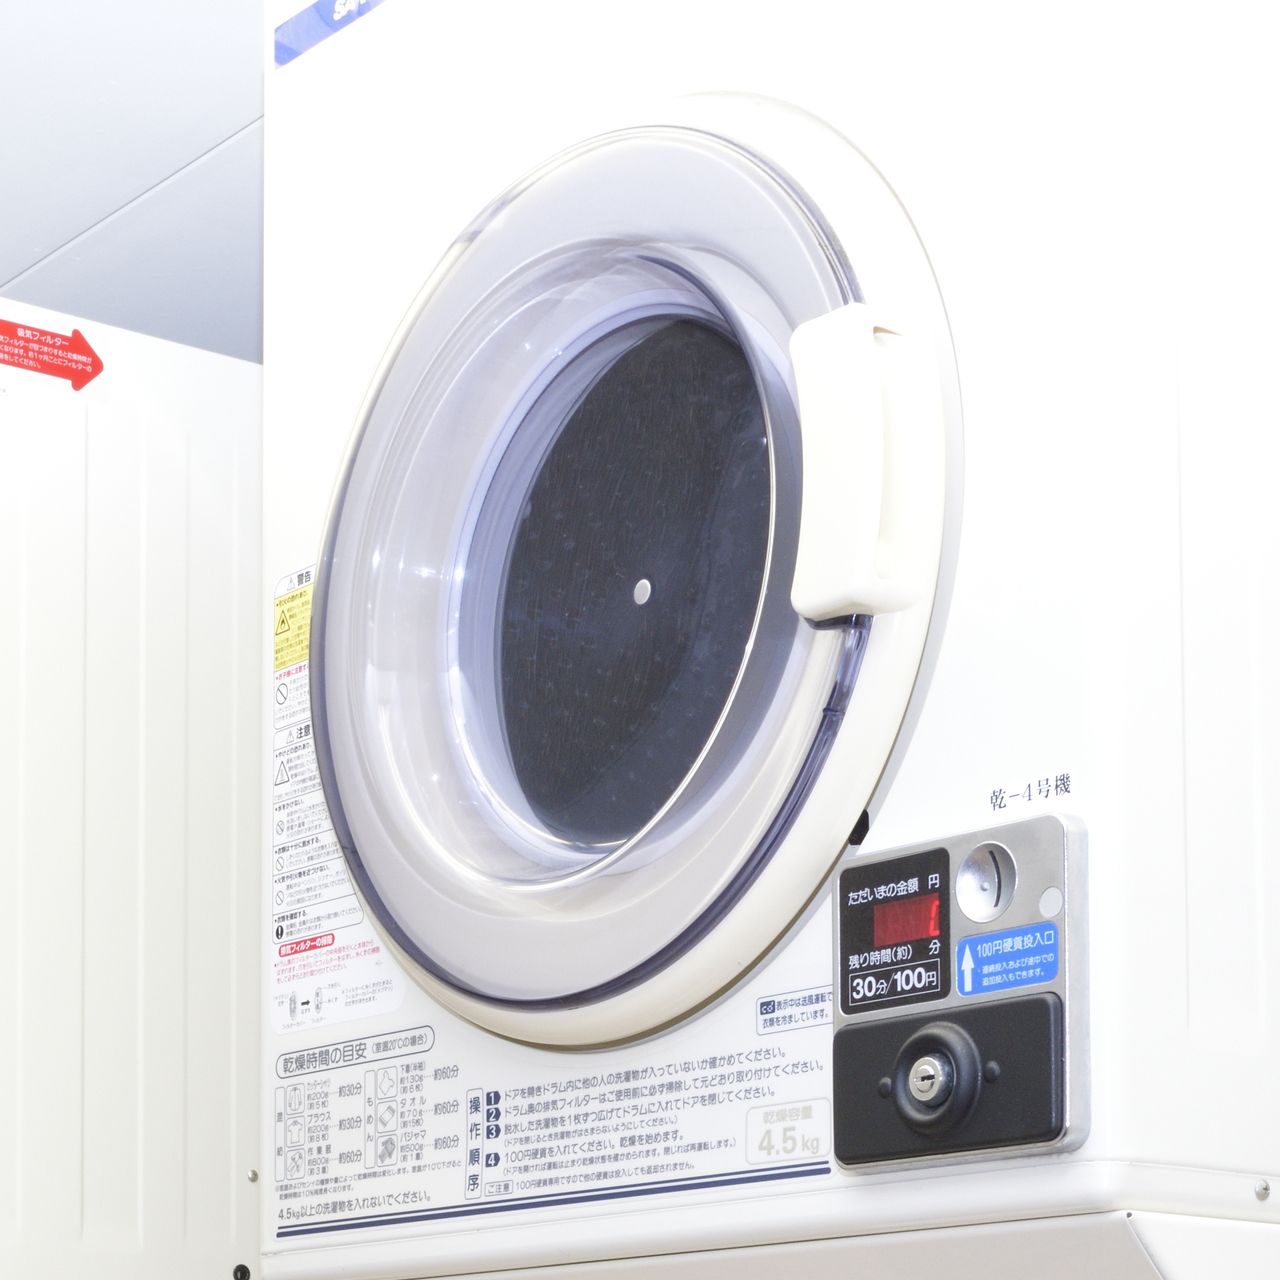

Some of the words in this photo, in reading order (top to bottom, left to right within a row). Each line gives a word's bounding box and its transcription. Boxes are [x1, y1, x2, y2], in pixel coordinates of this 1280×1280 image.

[296, 724, 311, 740] 注意
[848, 877, 919, 906] ただいまの金額
[928, 873, 940, 889] 円
[849, 944, 912, 969] 残り時間(約)
[929, 941, 941, 955] 分
[977, 930, 1054, 959] 100円硬貨投入口
[852, 967, 937, 1000] 30分/100円
[282, 1042, 366, 1074] 乾燥時間の目安
[434, 1064, 459, 1081] 約60分
[307, 1111, 331, 1123] ブラウス
[434, 1099, 459, 1116] 約60分
[434, 1134, 459, 1151] 約60分
[487, 1183, 510, 1194] ご注意
[278, 1186, 430, 1224] 4.5kg以上の洗濯物を入れないでください。
